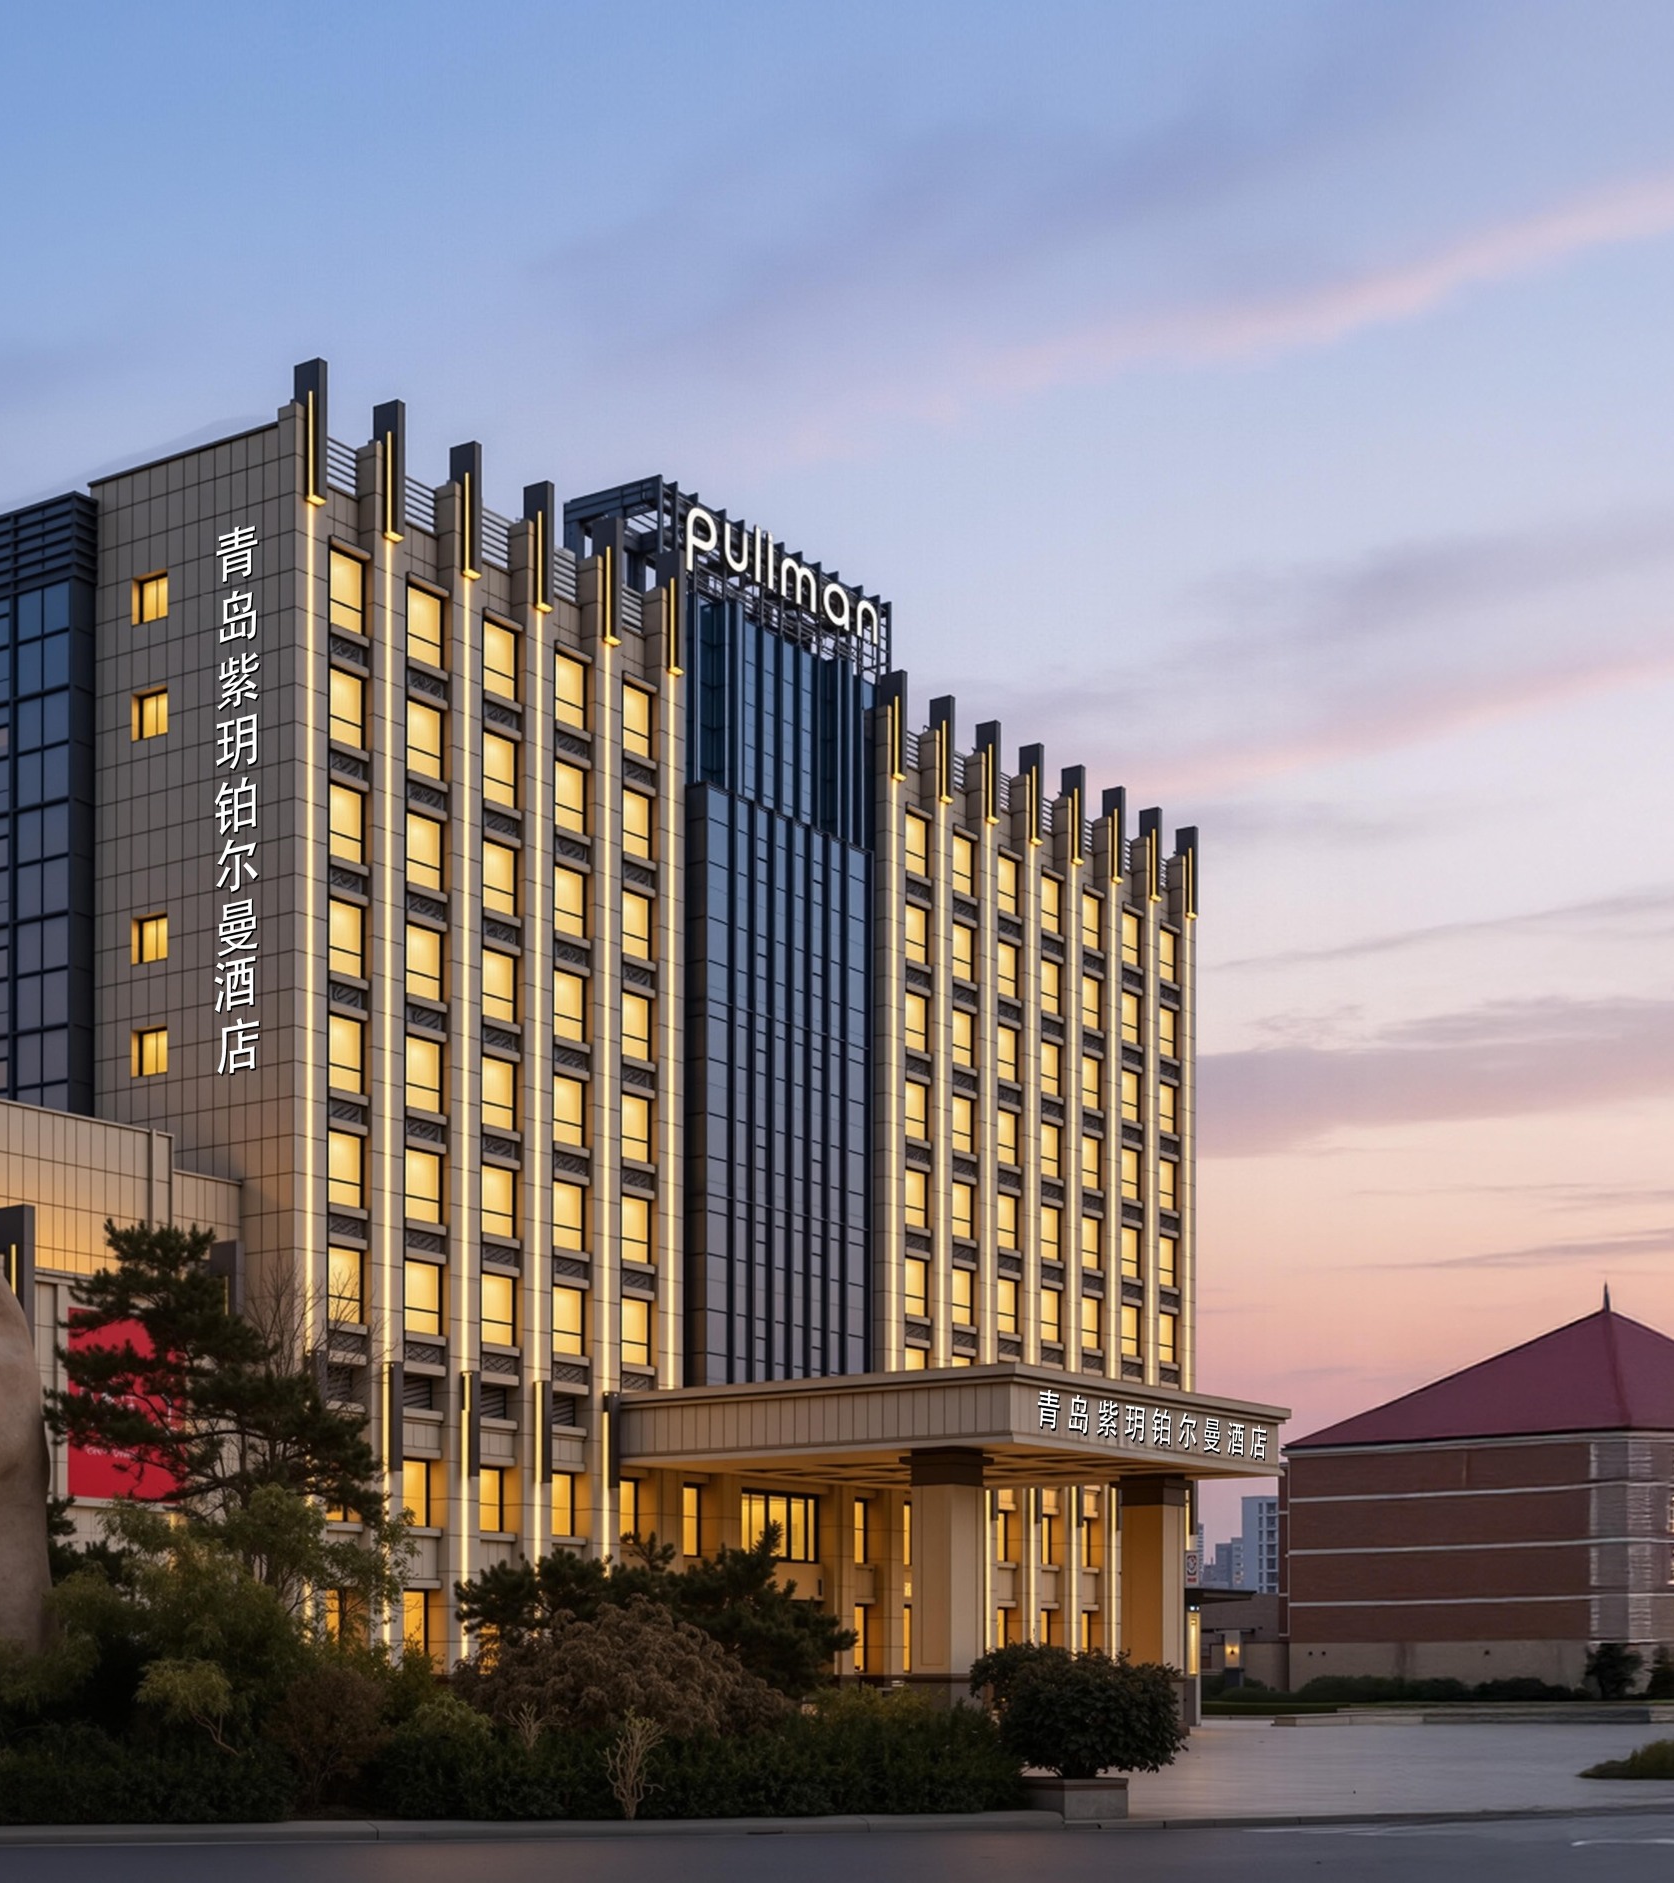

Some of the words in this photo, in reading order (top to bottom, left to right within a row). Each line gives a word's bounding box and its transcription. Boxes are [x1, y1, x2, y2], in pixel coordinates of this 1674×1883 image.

[686, 507, 879, 645] pullman
[214, 525, 260, 1076] 青岛紫玥铂尔曼酒店
[1037, 1389, 1268, 1460] 青岛紫玥铂尔曼酒店
